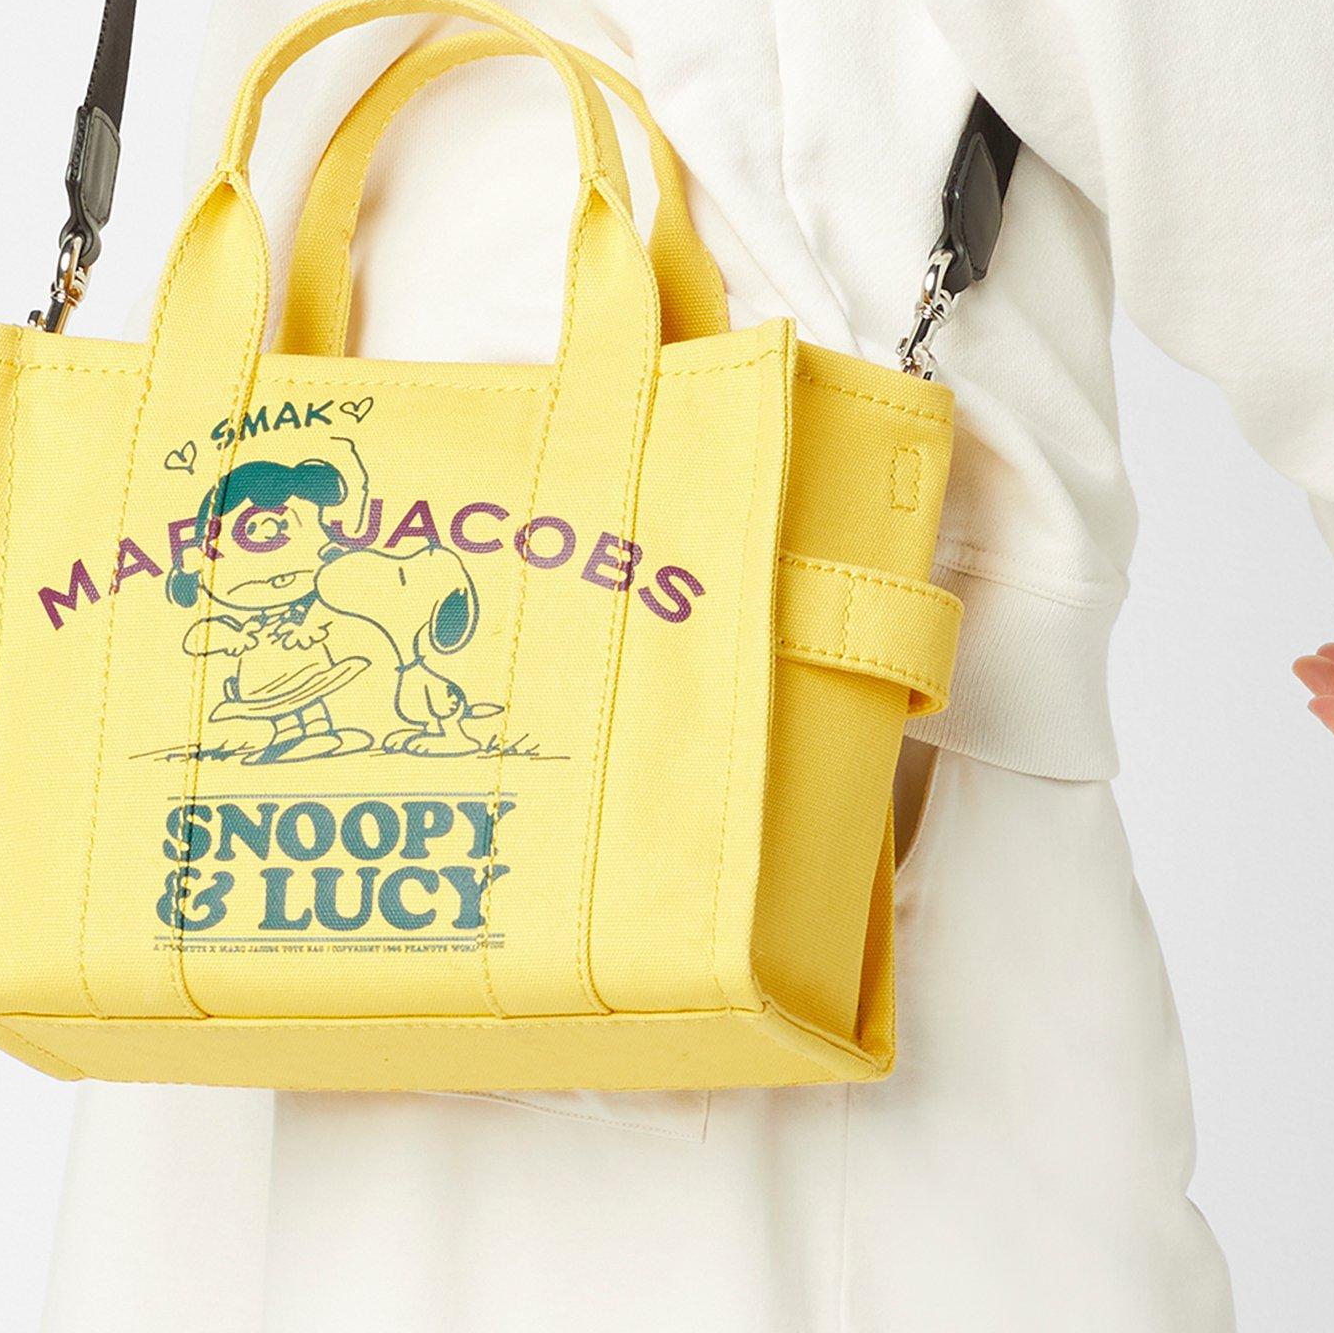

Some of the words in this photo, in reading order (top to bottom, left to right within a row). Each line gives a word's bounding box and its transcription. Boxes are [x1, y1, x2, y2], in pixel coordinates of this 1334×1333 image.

[210, 399, 335, 450] SMAK
[37, 502, 290, 631] MARC
[329, 498, 707, 624] JACOBS
[162, 800, 517, 862] SNOOPY
[155, 865, 235, 932] &
[258, 864, 511, 931] LUCY
